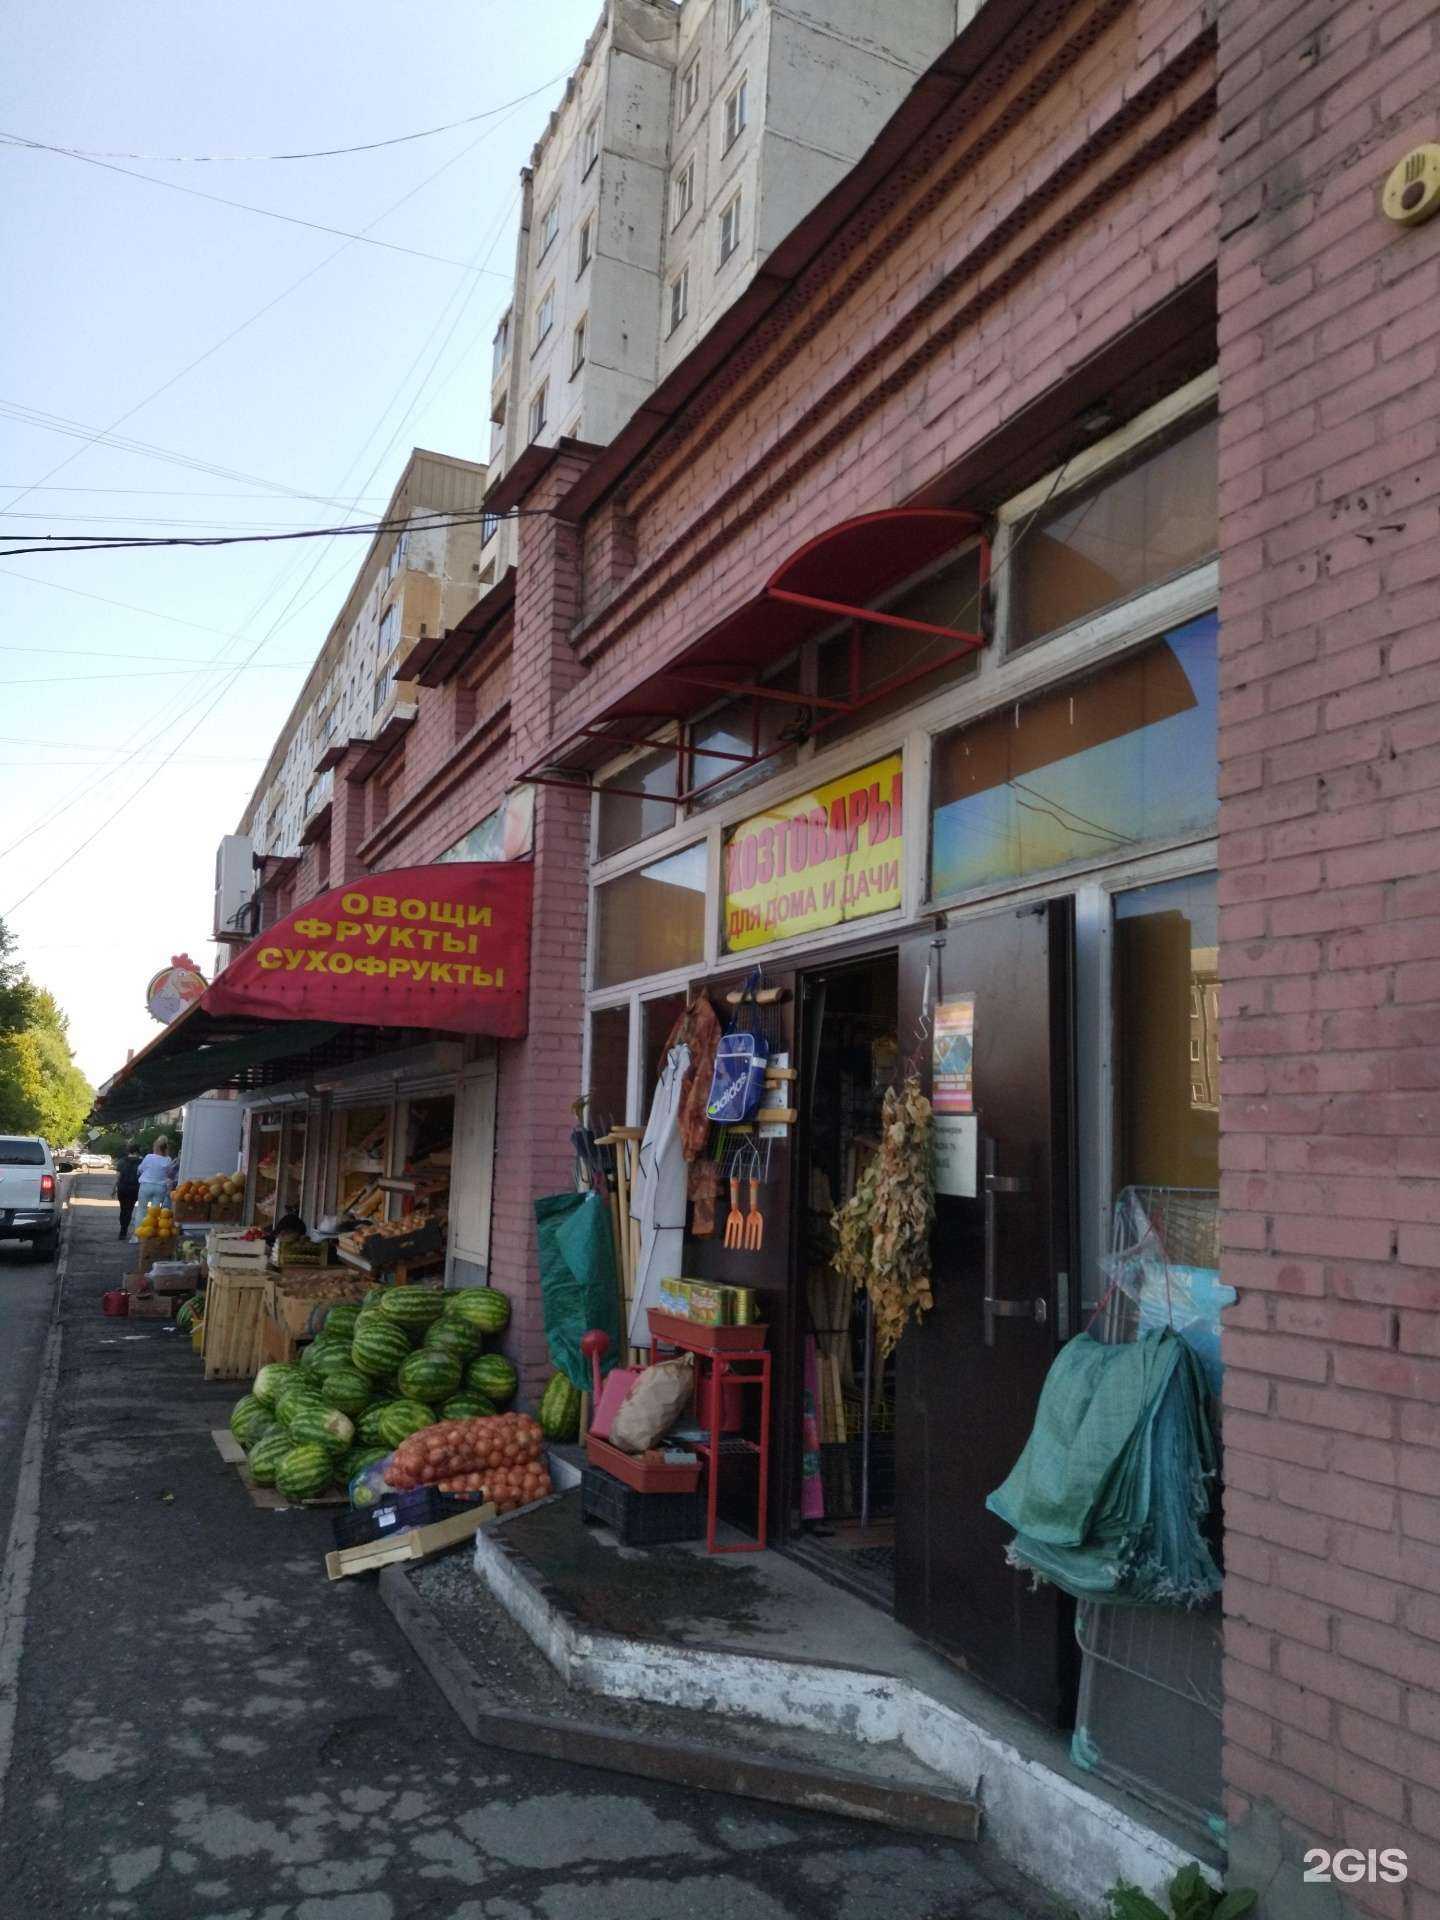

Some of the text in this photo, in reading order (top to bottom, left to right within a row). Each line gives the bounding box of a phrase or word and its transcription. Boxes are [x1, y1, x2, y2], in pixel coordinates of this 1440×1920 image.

[341, 892, 493, 928] ОВОЩИ
[730, 860, 898, 938] ДЛЯ ДОМА И ДАЧИ
[293, 918, 478, 954] ФРУКТЫ
[256, 947, 504, 987] СУХОФРУКТЫ
